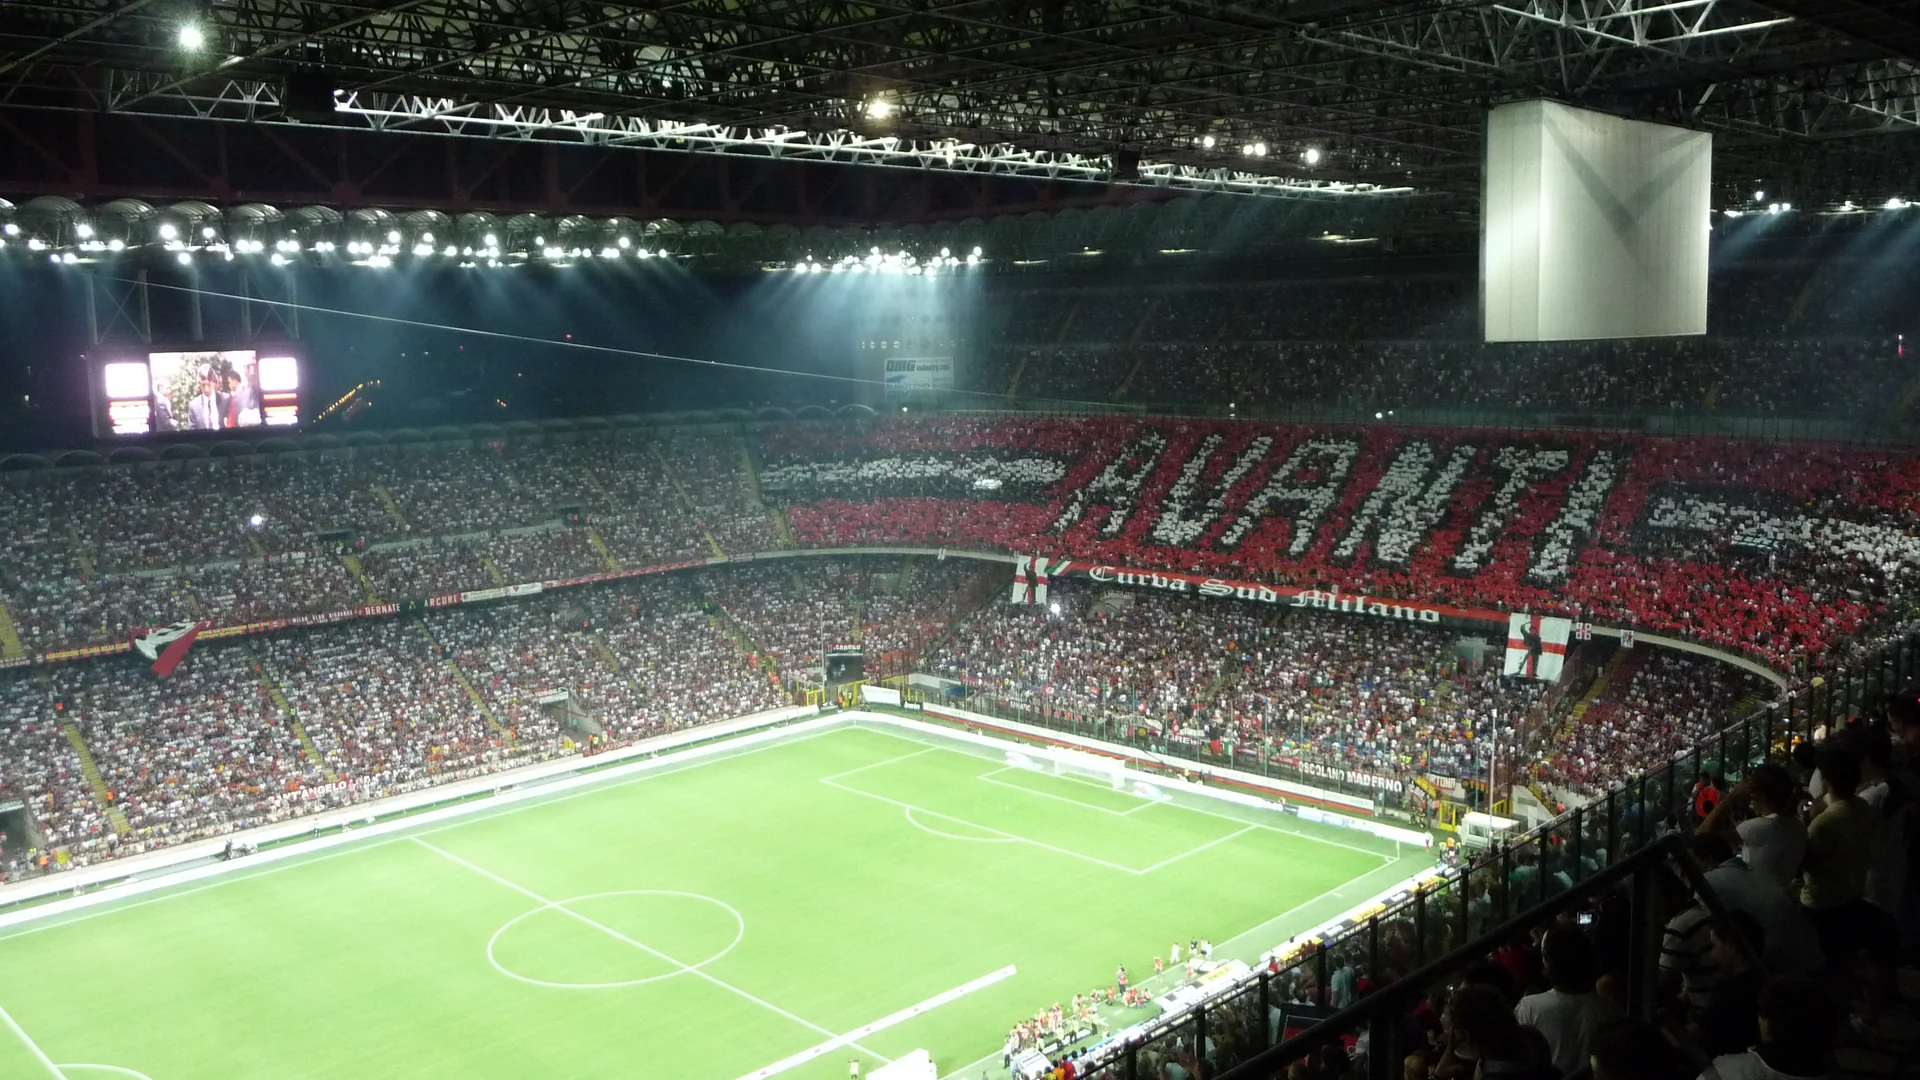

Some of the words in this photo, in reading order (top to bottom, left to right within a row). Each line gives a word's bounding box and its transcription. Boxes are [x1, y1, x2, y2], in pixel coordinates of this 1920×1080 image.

[423, 594, 458, 608] ARCORE
[1088, 565, 1188, 592] Curva
[1198, 578, 1278, 603] Sud
[1289, 585, 1440, 624] Milano
[364, 602, 401, 616] BERNATE
[1346, 770, 1403, 793] MADERNO
